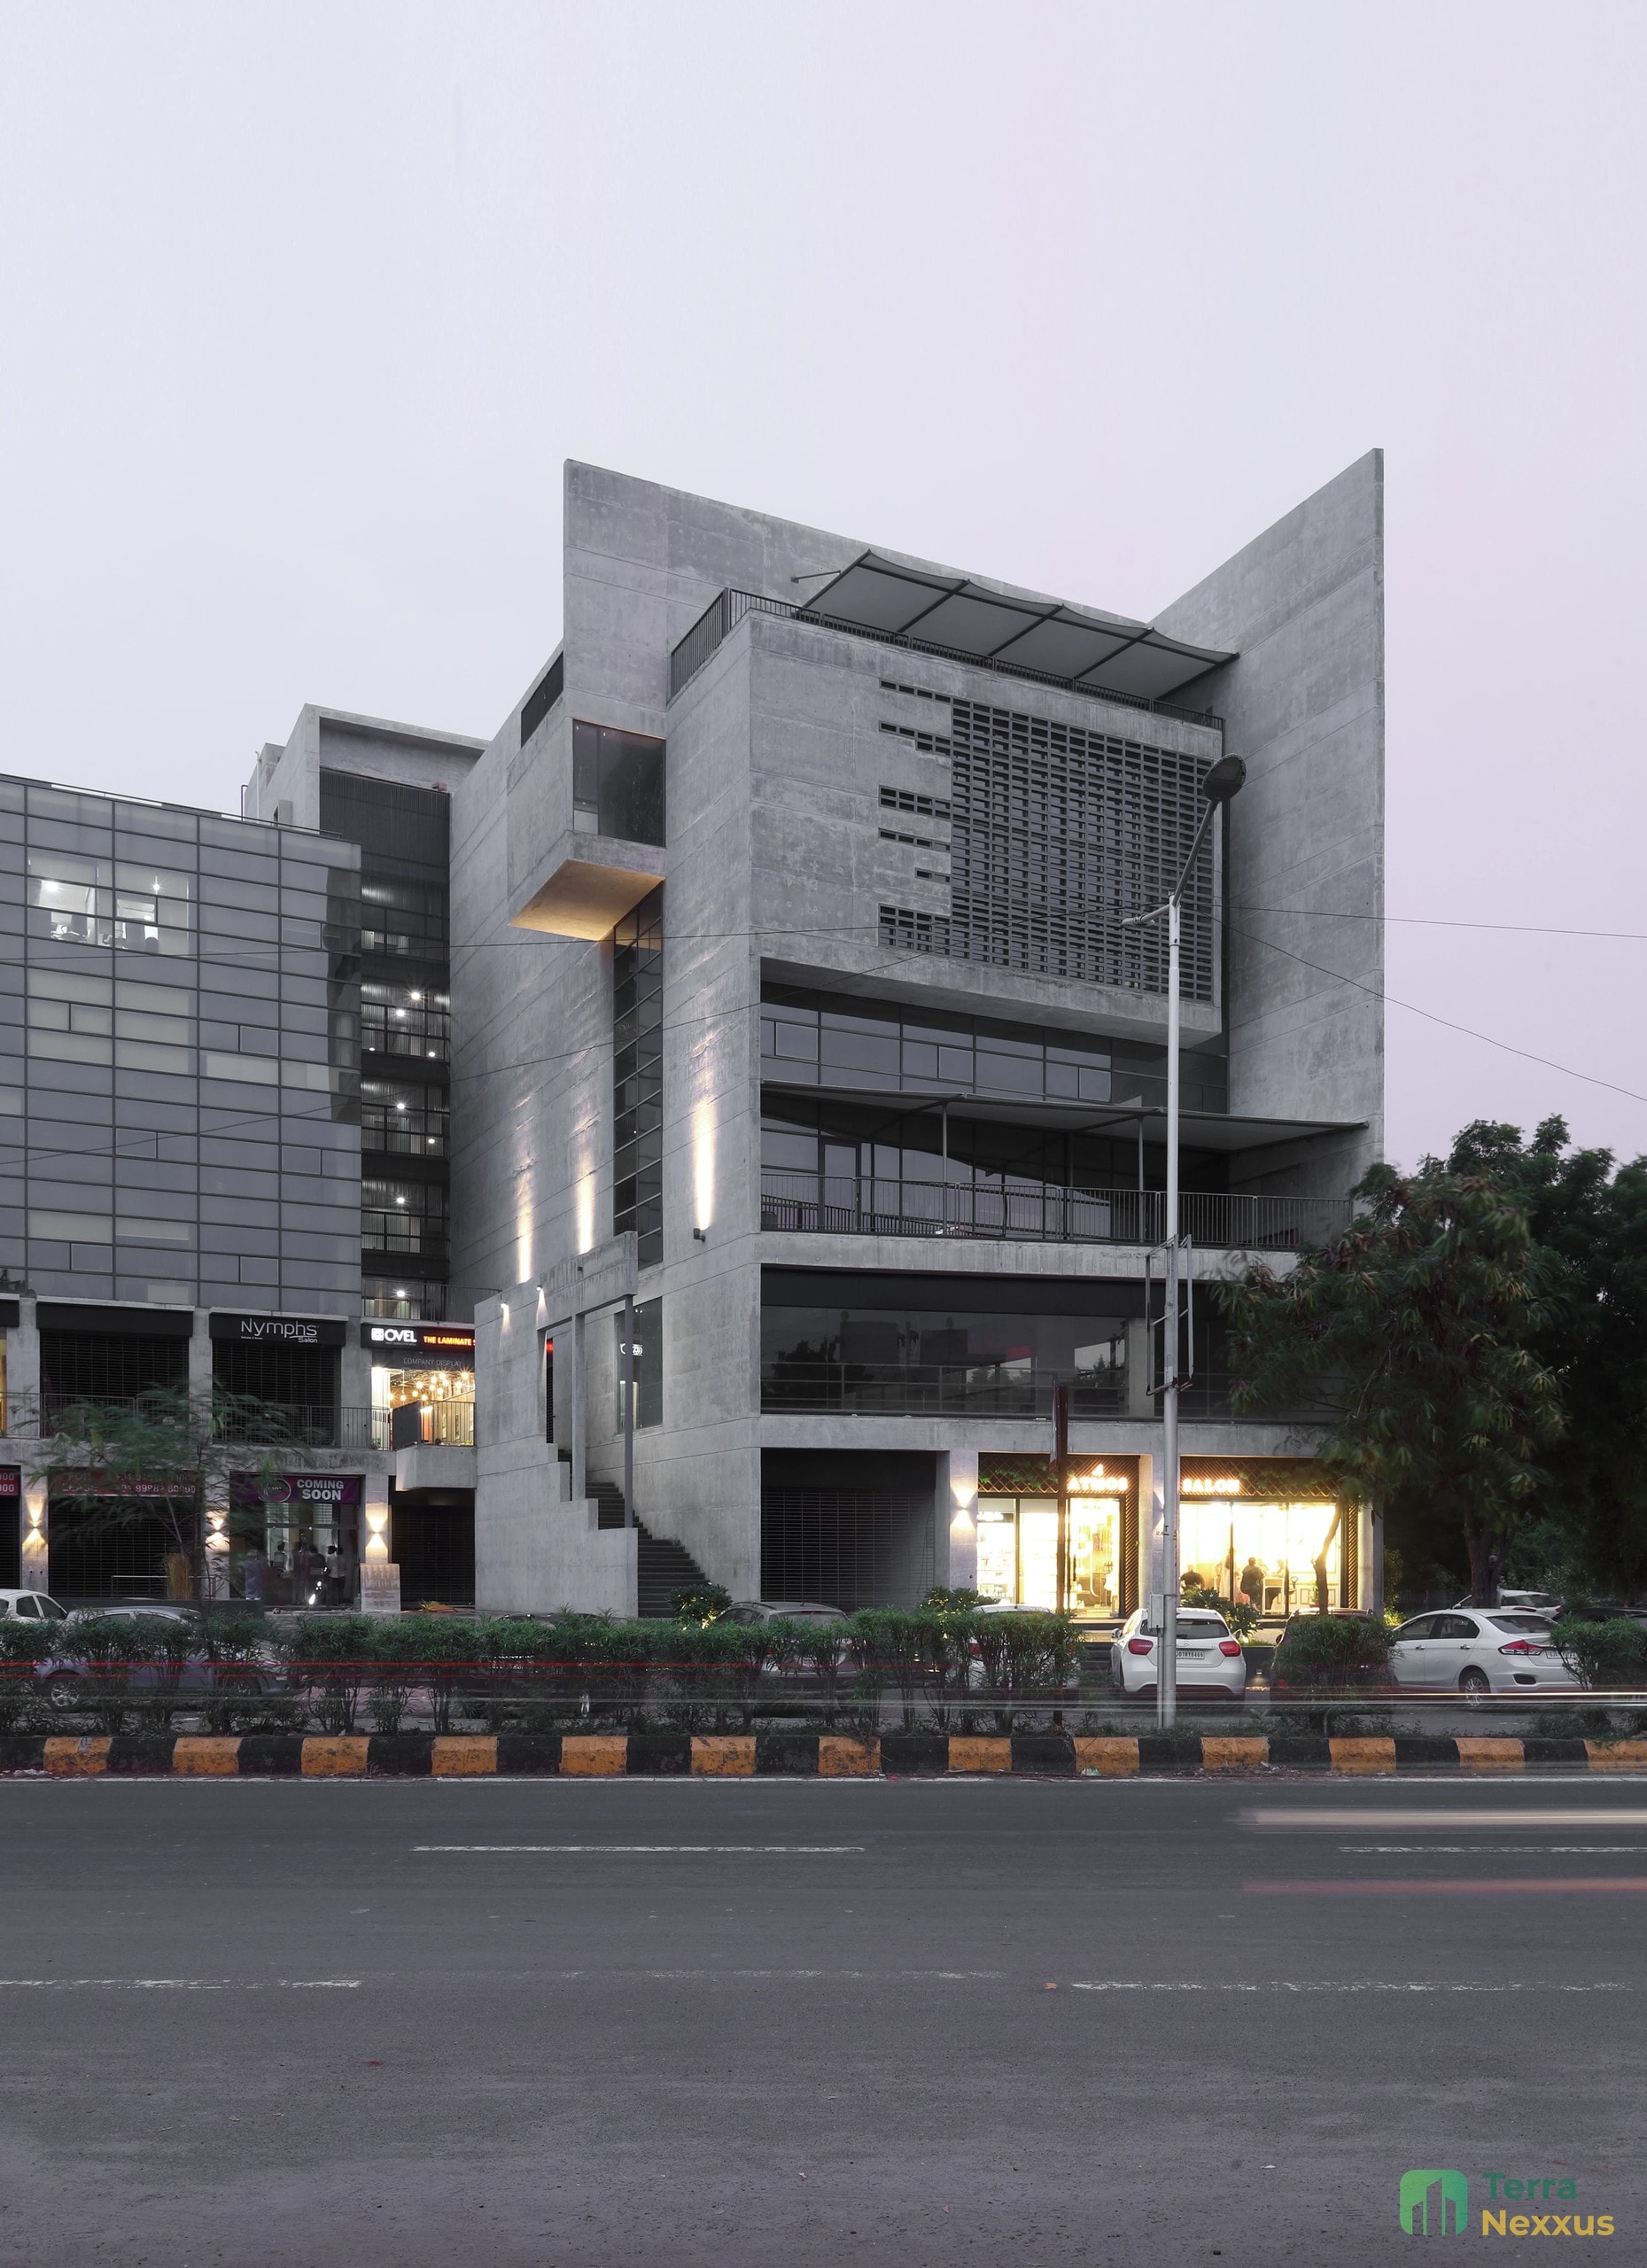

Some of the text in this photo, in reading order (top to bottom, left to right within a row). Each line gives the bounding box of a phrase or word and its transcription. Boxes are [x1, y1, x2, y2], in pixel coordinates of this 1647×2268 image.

[241, 1317, 318, 1339] Nymphs
[423, 1335, 437, 1344] THE
[438, 1337, 472, 1346] LAMINATE
[296, 1479, 345, 1489] COMING
[1182, 1478, 1240, 1493] SALON
[301, 1489, 342, 1501] SOON
